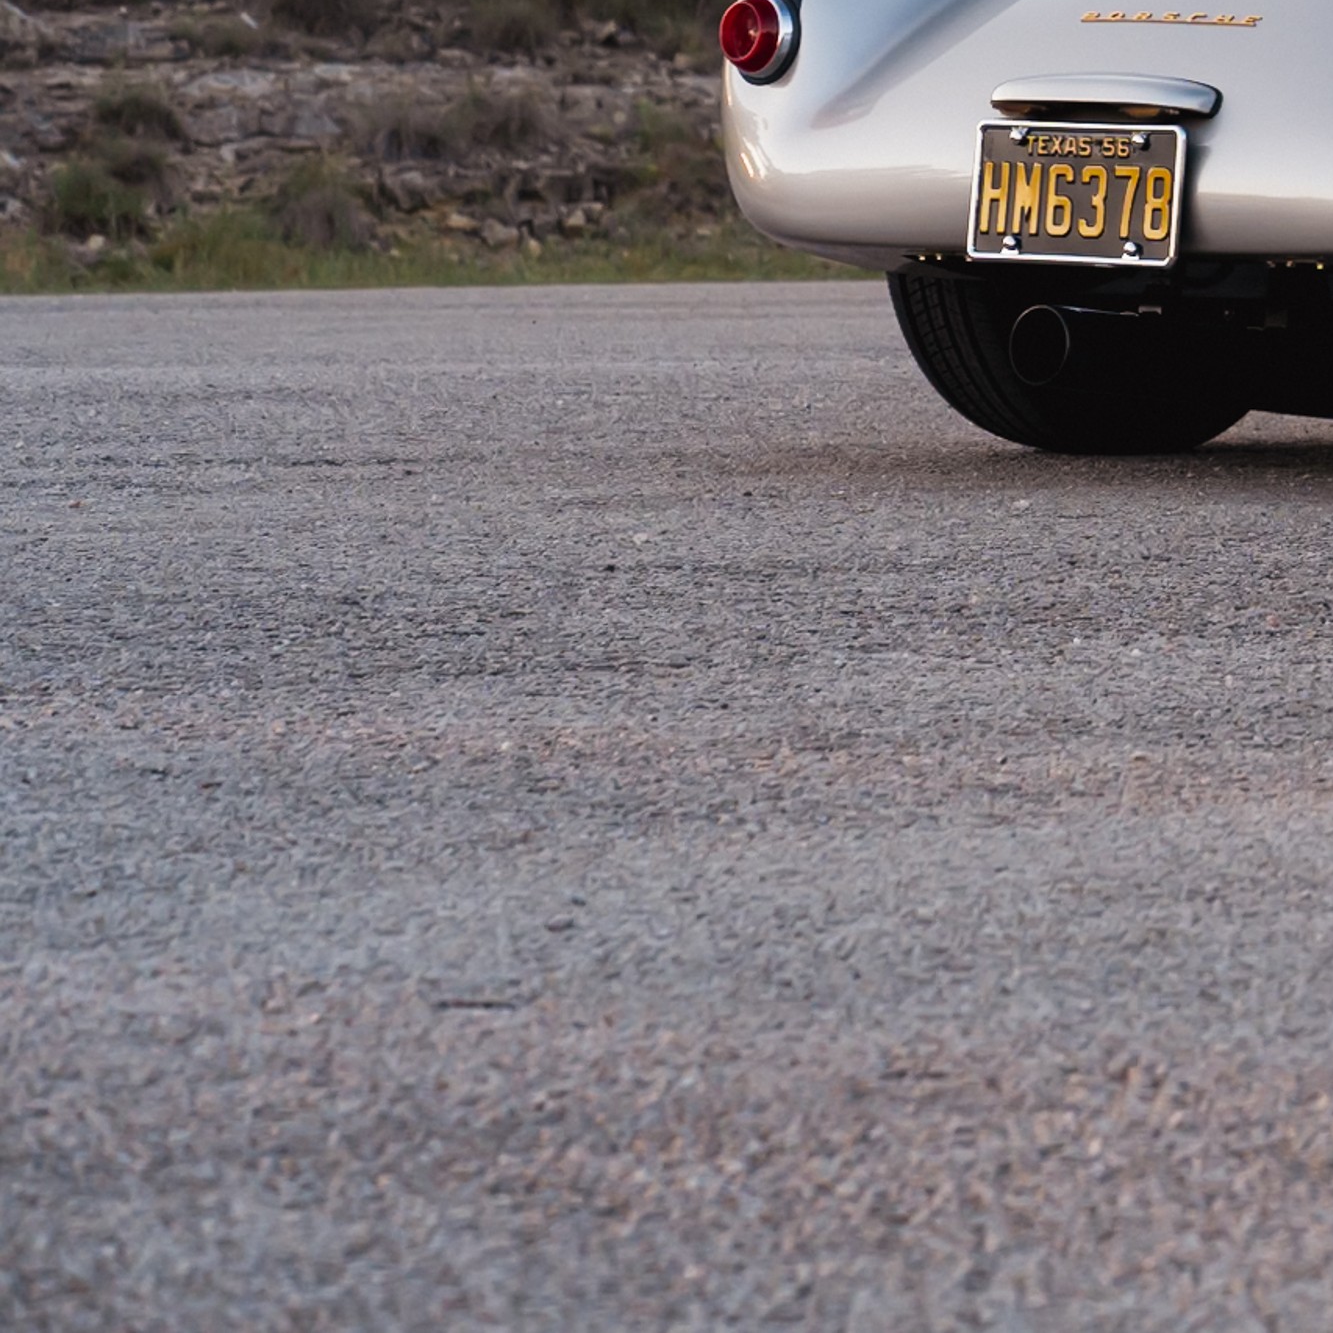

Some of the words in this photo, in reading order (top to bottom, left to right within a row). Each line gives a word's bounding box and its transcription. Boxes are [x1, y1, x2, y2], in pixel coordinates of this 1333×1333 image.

[1080, 10, 1263, 27] PORSCHE
[1027, 134, 1091, 157] TEXAS
[1102, 137, 1131, 158] 56
[979, 161, 1173, 241] HM6378
